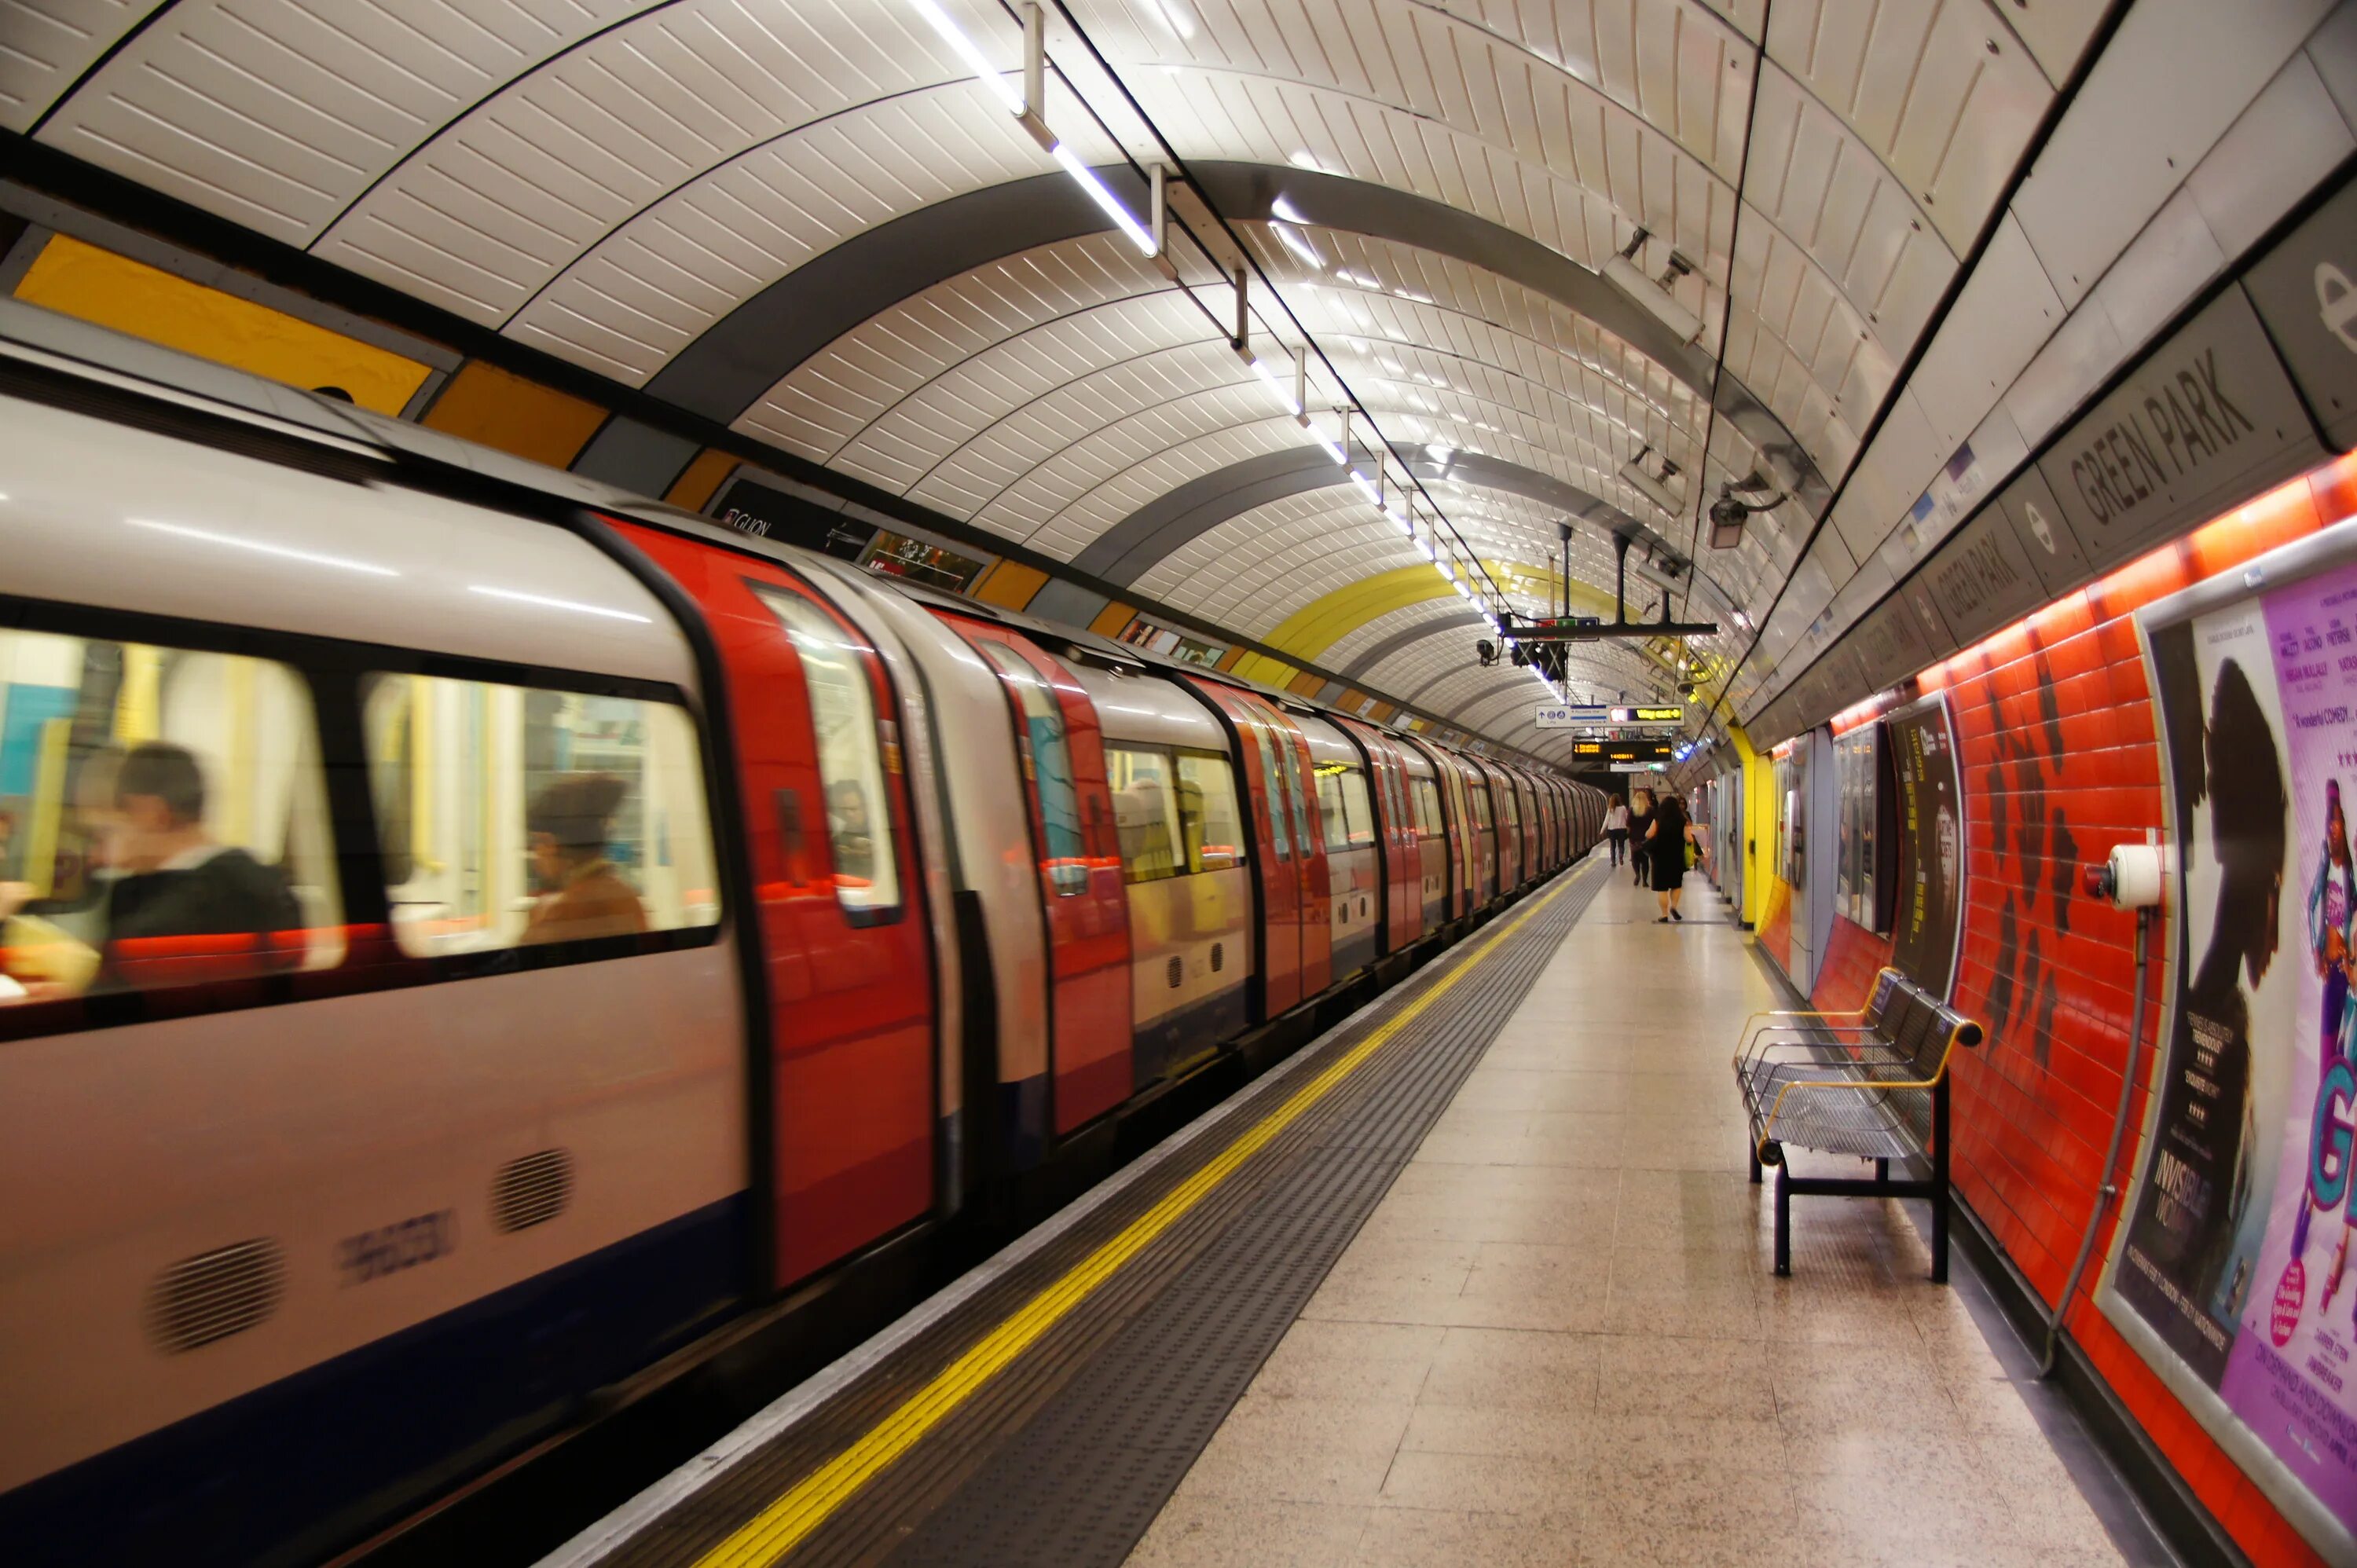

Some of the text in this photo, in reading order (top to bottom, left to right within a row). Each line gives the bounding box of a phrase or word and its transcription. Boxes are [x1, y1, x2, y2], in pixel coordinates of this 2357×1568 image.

[2071, 347, 2255, 526] GREEN PARK
[1937, 529, 2019, 619] GREEN PARK
[1637, 709, 1672, 720] Way out
[2154, 1149, 2212, 1220] INVISIBLE
[2158, 1277, 2179, 1304] LONDON
